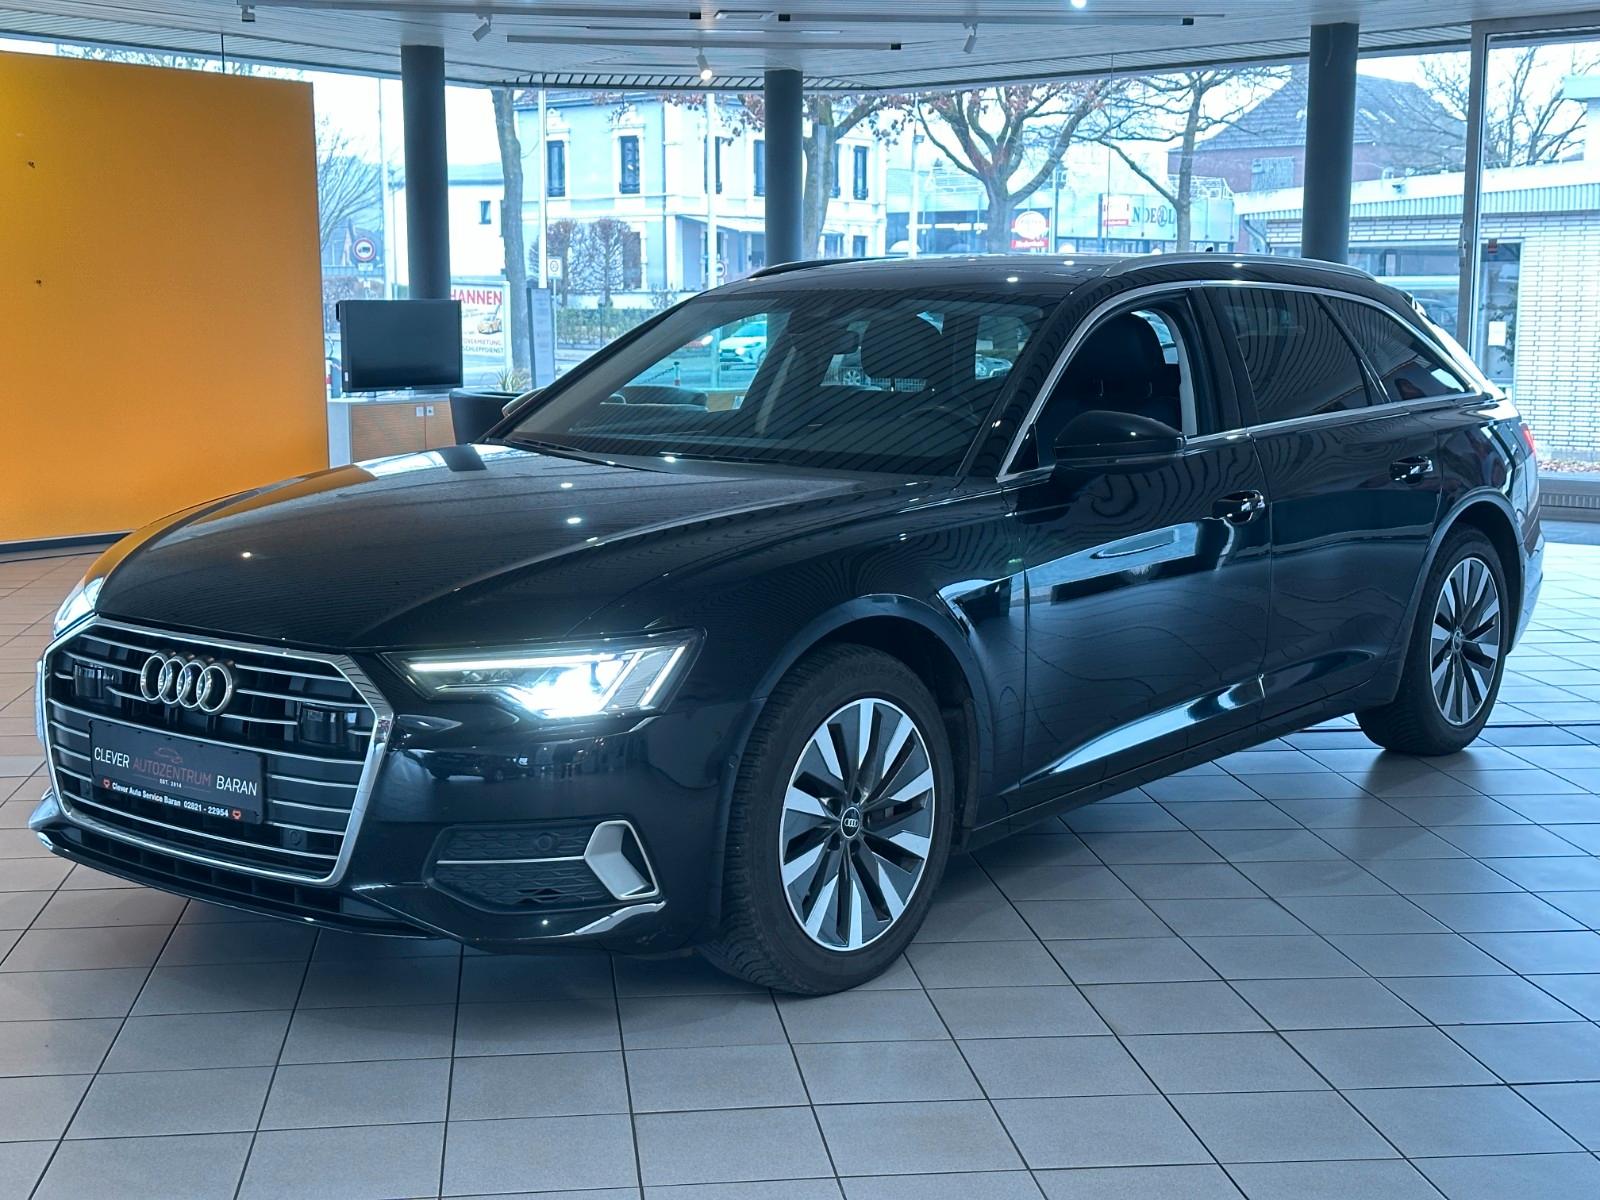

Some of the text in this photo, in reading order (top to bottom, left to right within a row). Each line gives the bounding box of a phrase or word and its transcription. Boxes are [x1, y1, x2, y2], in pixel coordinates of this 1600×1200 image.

[94, 746, 258, 797] CLEVER AUTOZENTRUM BARAN
[112, 781, 129, 793] Clever
[128, 786, 142, 797] Auto
[142, 790, 163, 803] Service
[163, 795, 181, 807] Baran
[183, 800, 202, 812] 02821
[207, 805, 229, 817] 22954
